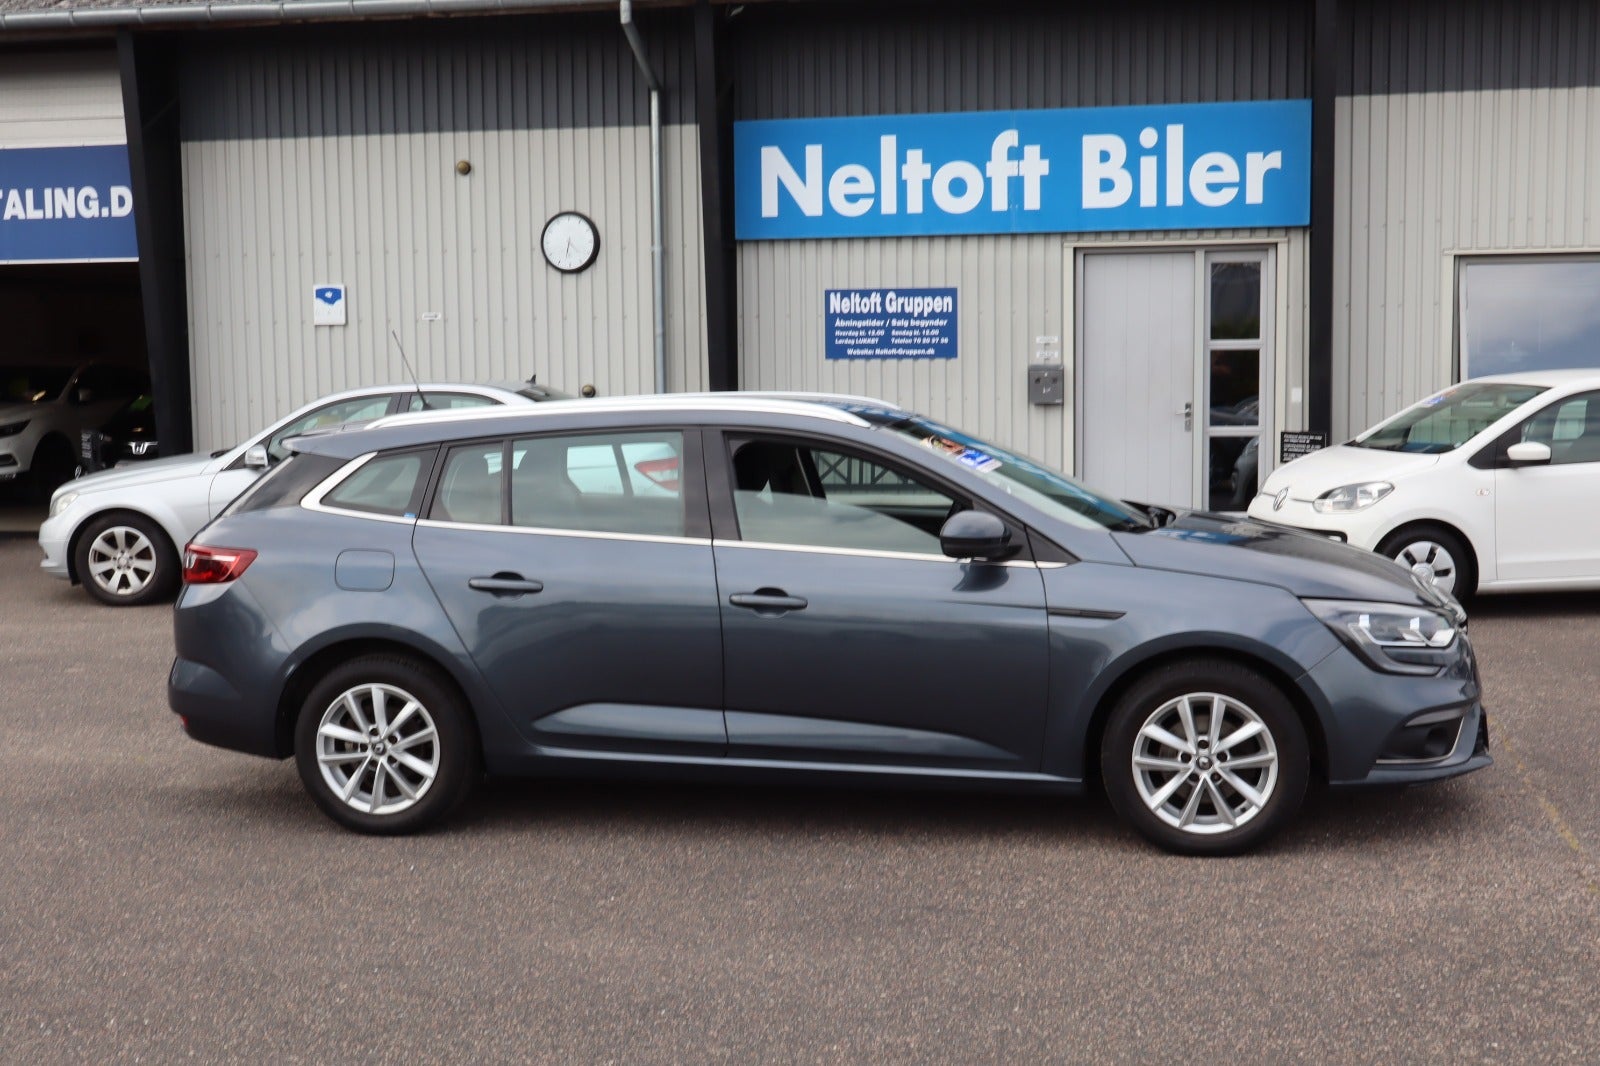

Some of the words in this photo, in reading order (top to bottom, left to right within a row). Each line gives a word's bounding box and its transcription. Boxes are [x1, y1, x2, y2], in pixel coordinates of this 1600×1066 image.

[761, 129, 1050, 218] Neltoft
[1082, 123, 1282, 210] Biler
[0, 185, 133, 220] ALING.D
[829, 291, 882, 314] Neltoft
[885, 291, 953, 317] Gruppen
